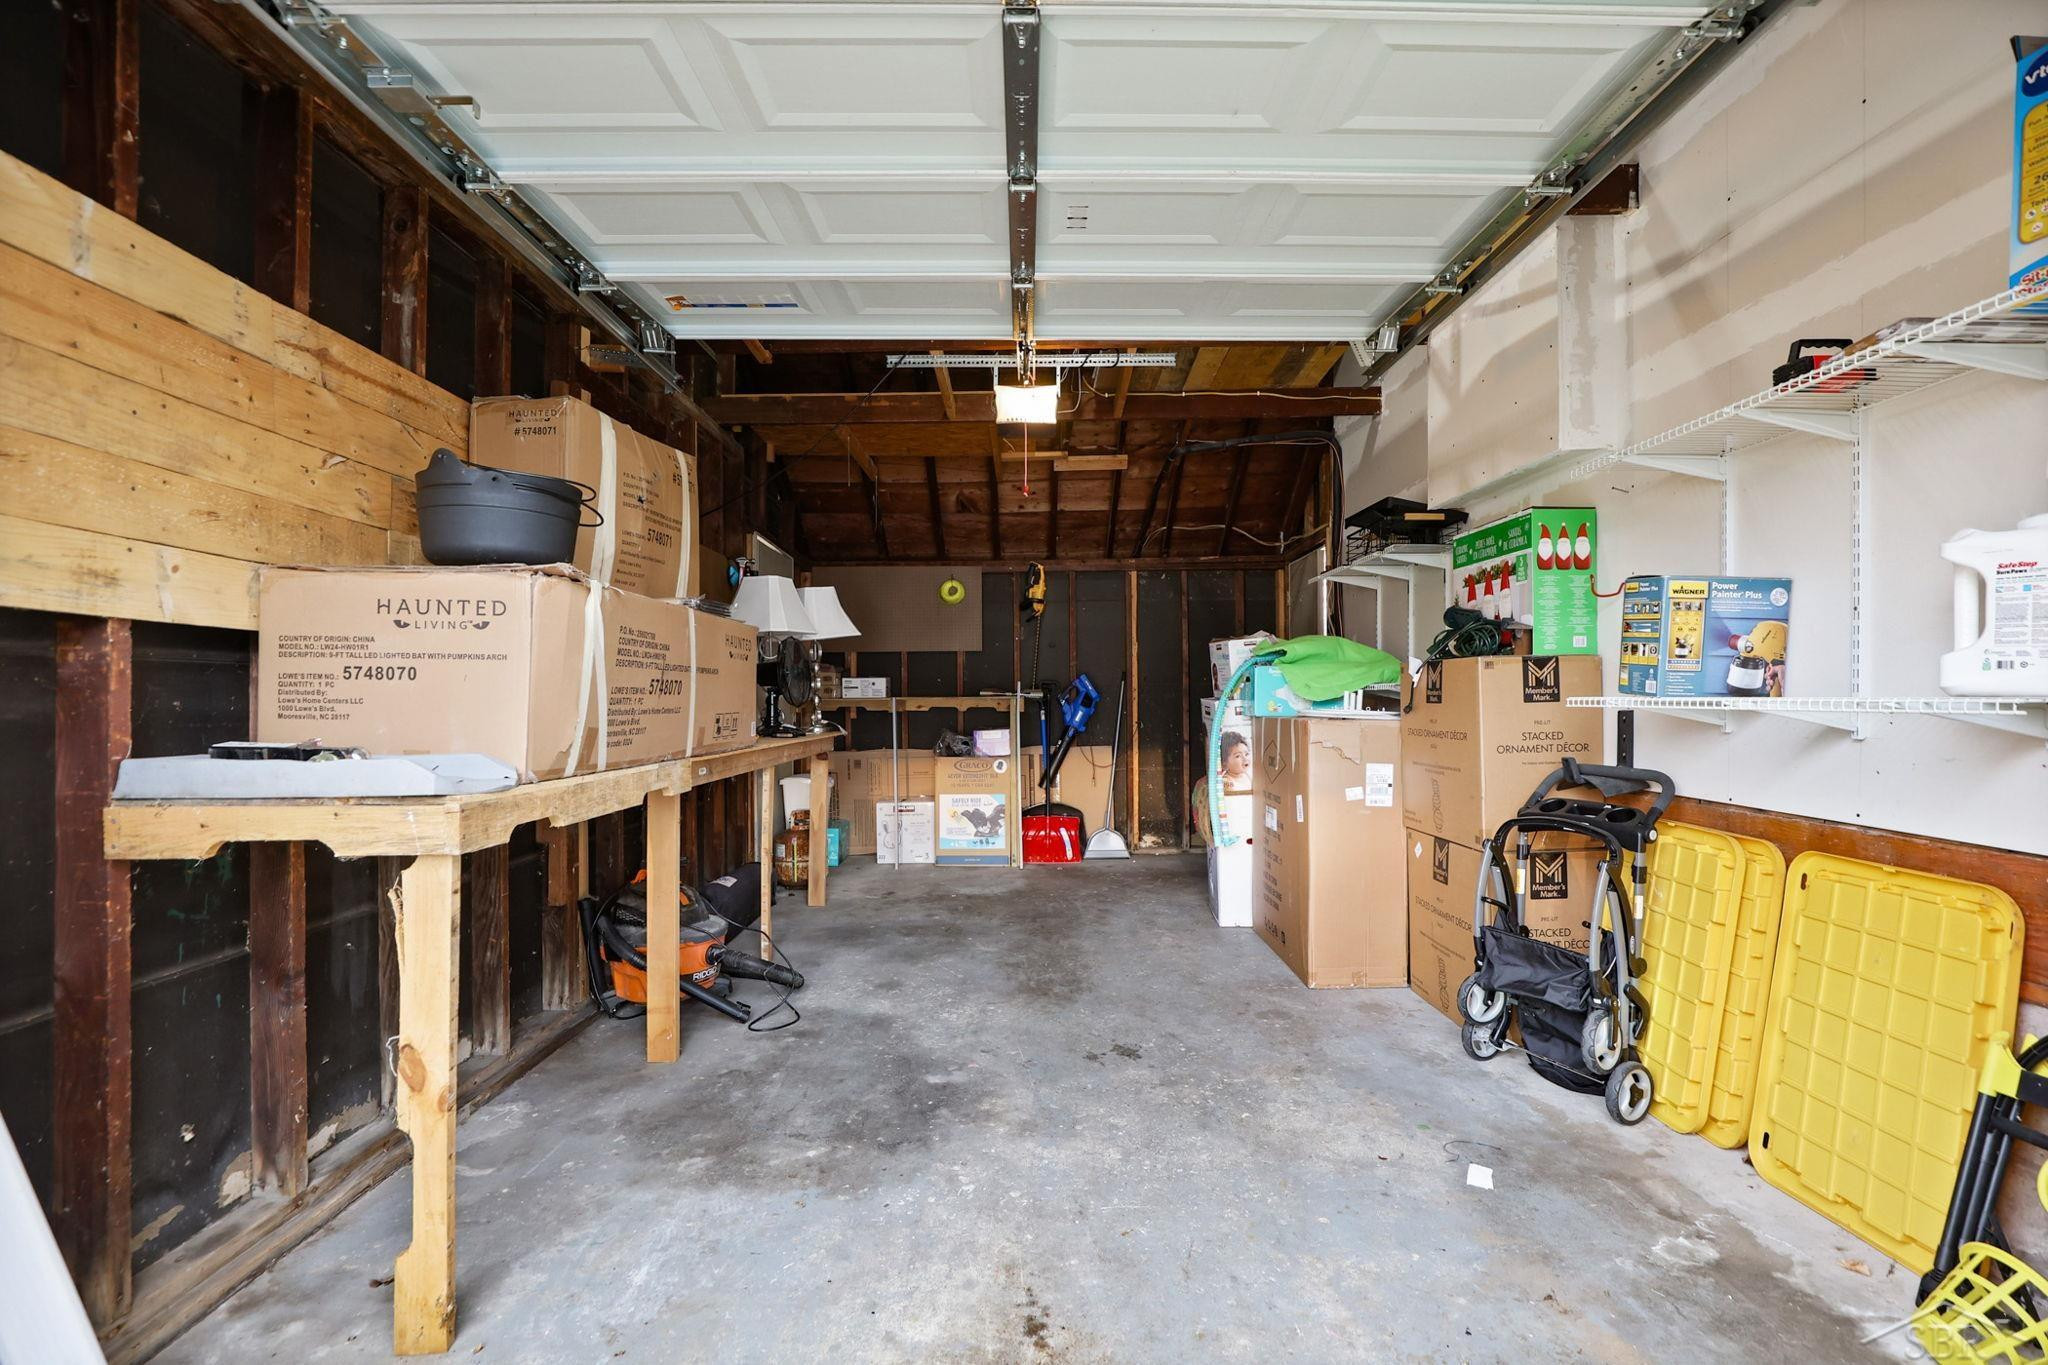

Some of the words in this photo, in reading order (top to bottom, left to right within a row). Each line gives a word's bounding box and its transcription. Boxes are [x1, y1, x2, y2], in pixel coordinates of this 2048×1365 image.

[507, 408, 558, 418] HAUNTED
[647, 528, 673, 549] 5748071
[1672, 586, 1706, 596] WAGNER
[1711, 582, 1738, 591] Power
[1744, 591, 1763, 600] Plus
[377, 598, 507, 617] HAUNTED
[414, 620, 468, 630] LIVING
[278, 635, 312, 643] COUNTRY
[313, 635, 322, 643] OF
[323, 635, 351, 643] ORIGIN:
[618, 637, 639, 648] COUNTRY
[278, 643, 303, 651] MODEL
[278, 651, 328, 659] DESCRIPTION:
[447, 653, 486, 661] PUMPKINS
[616, 648, 632, 658] MODEL
[278, 673, 305, 681] LOWE'S
[306, 673, 324, 681] ITEM
[343, 665, 418, 682] 5748070
[278, 681, 316, 689] QUANTITY:
[318, 681, 323, 689] 1
[648, 678, 683, 697] 5748070
[278, 689, 316, 697] Distributed
[316, 690, 328, 699] By:
[1525, 687, 1559, 695] Member's
[278, 697, 302, 705] Lowe's
[278, 705, 294, 713] 1000
[295, 705, 318, 713] Lowe's
[278, 713, 319, 722] Mooresville,
[1521, 731, 1565, 742] STACKED
[1496, 743, 1555, 755] ORNAMENT
[1556, 741, 1592, 753] DÉCOR
[959, 761, 988, 769] GRACO
[1532, 883, 1566, 892] Member's
[1529, 927, 1572, 939] STACKED
[693, 965, 718, 981] RIDGID
